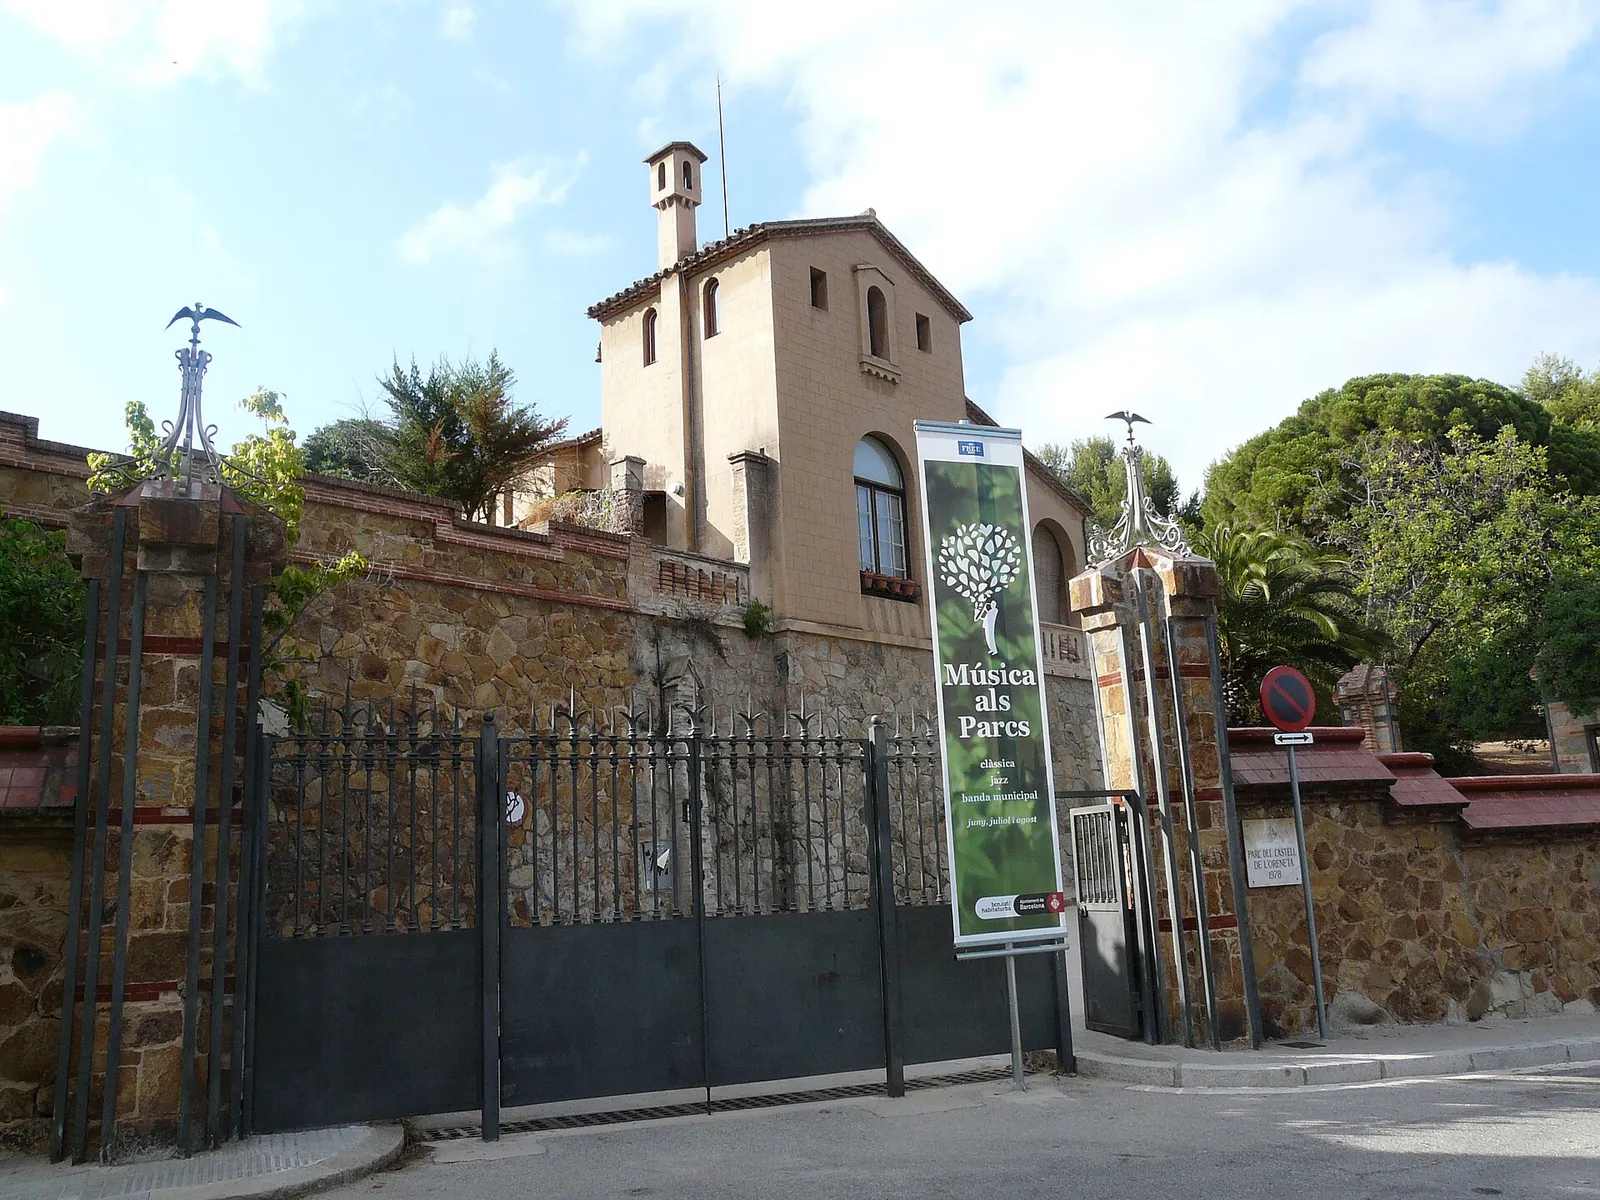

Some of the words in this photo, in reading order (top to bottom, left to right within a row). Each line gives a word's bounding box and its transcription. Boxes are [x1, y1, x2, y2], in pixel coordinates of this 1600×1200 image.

[944, 662, 1036, 686] Música
[975, 688, 1010, 712] als
[958, 716, 1030, 738] Parcs
[980, 758, 1015, 768] clàssica
[990, 776, 1008, 786] jazz
[962, 793, 990, 802] banda
[993, 790, 1038, 803] municipal
[989, 816, 1010, 826] juliol
[1016, 816, 1037, 825] agost
[1248, 850, 1261, 859] PARC
[1262, 849, 1273, 858] DEL
[1274, 848, 1297, 857] CASTELL
[1254, 860, 1262, 869] DE
[1268, 870, 1282, 880] 1978
